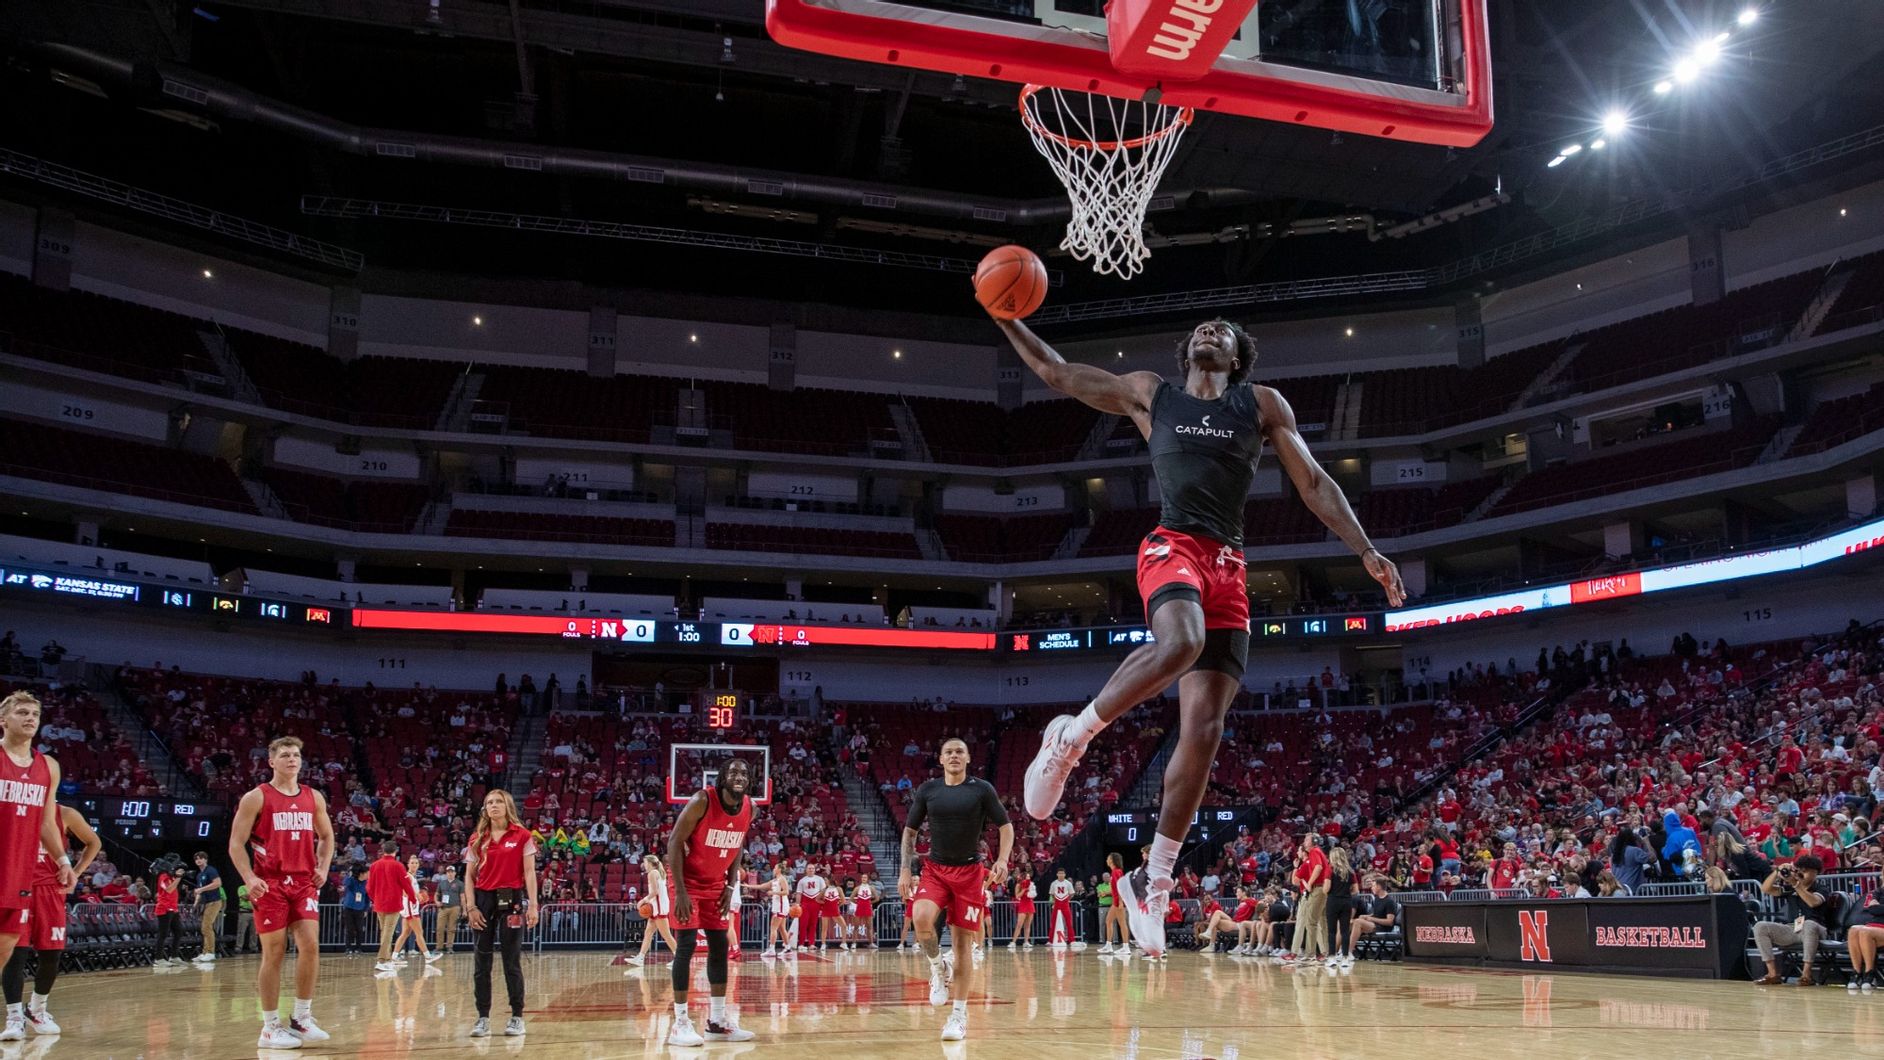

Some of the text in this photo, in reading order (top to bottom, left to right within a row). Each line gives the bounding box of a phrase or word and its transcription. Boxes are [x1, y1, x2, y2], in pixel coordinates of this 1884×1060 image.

[41, 239, 70, 254] 309
[333, 316, 357, 327] 310
[1459, 326, 1479, 338] 315
[592, 336, 614, 345] 311
[772, 351, 793, 360] 312
[63, 405, 94, 420] 209
[1704, 400, 1730, 414] 216
[1175, 425, 1234, 439] CATAPULT
[362, 461, 387, 471] 210
[563, 472, 587, 481] 211
[1400, 467, 1423, 477] 215
[791, 485, 814, 496] 212
[1017, 496, 1038, 506] 213
[6, 574, 28, 584] AT
[55, 577, 135, 595] KANSAS STATE
[1743, 608, 1772, 621] 115
[567, 621, 577, 631] 0
[601, 622, 618, 638] N
[636, 625, 647, 638] 0
[682, 623, 694, 632] 1st
[679, 632, 700, 642] 1:00
[729, 628, 740, 641] 0
[797, 630, 806, 640] 0
[1047, 633, 1071, 642] MEN'S
[1113, 633, 1128, 642] AT
[1039, 639, 1079, 650] SCHEDULE
[378, 659, 405, 669] 111
[1408, 655, 1430, 668] 114
[787, 671, 812, 681] 112
[1007, 677, 1029, 687] 113
[716, 695, 737, 708] 1:00
[709, 707, 733, 728] 30
[16, 805, 28, 817] N
[121, 801, 150, 818] 1:00
[174, 804, 194, 815] RED
[272, 811, 314, 831] NEBRASKA
[1108, 814, 1133, 824] WHITE
[1216, 811, 1234, 821] RED
[152, 828, 159, 836] 4
[198, 821, 210, 837] 0
[1128, 827, 1137, 841] 0
[291, 831, 301, 841] N
[1202, 833, 1209, 841] 4
[807, 881, 816, 890] N
[1057, 886, 1065, 894] N
[305, 898, 320, 913] N
[964, 905, 980, 923] N
[51, 927, 66, 941] N
[1415, 926, 1476, 944] NEBRASKA
[1518, 910, 1552, 962] N
[1595, 926, 1706, 948] BASKETBALL
